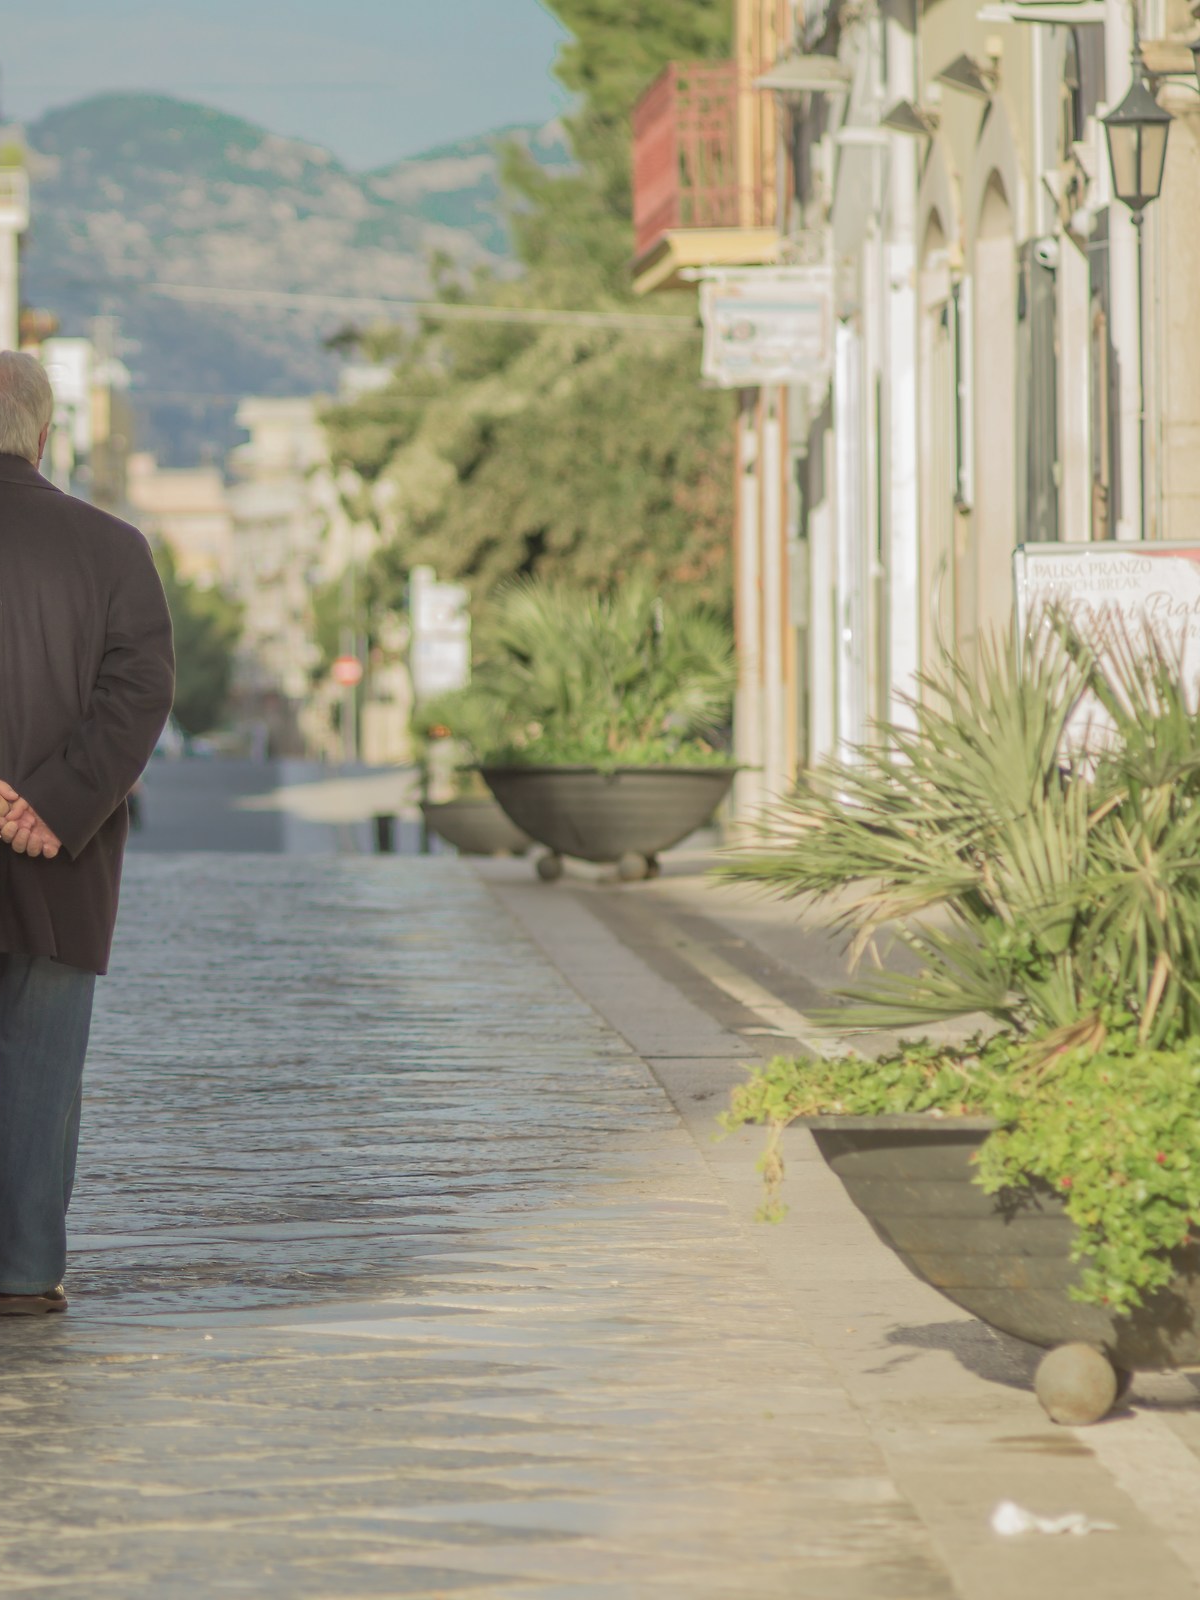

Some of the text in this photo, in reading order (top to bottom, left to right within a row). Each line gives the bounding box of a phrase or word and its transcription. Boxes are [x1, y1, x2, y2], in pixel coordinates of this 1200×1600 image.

[1034, 559, 1152, 579] PAUSA PRANZO
[1098, 576, 1142, 591] BREAK
